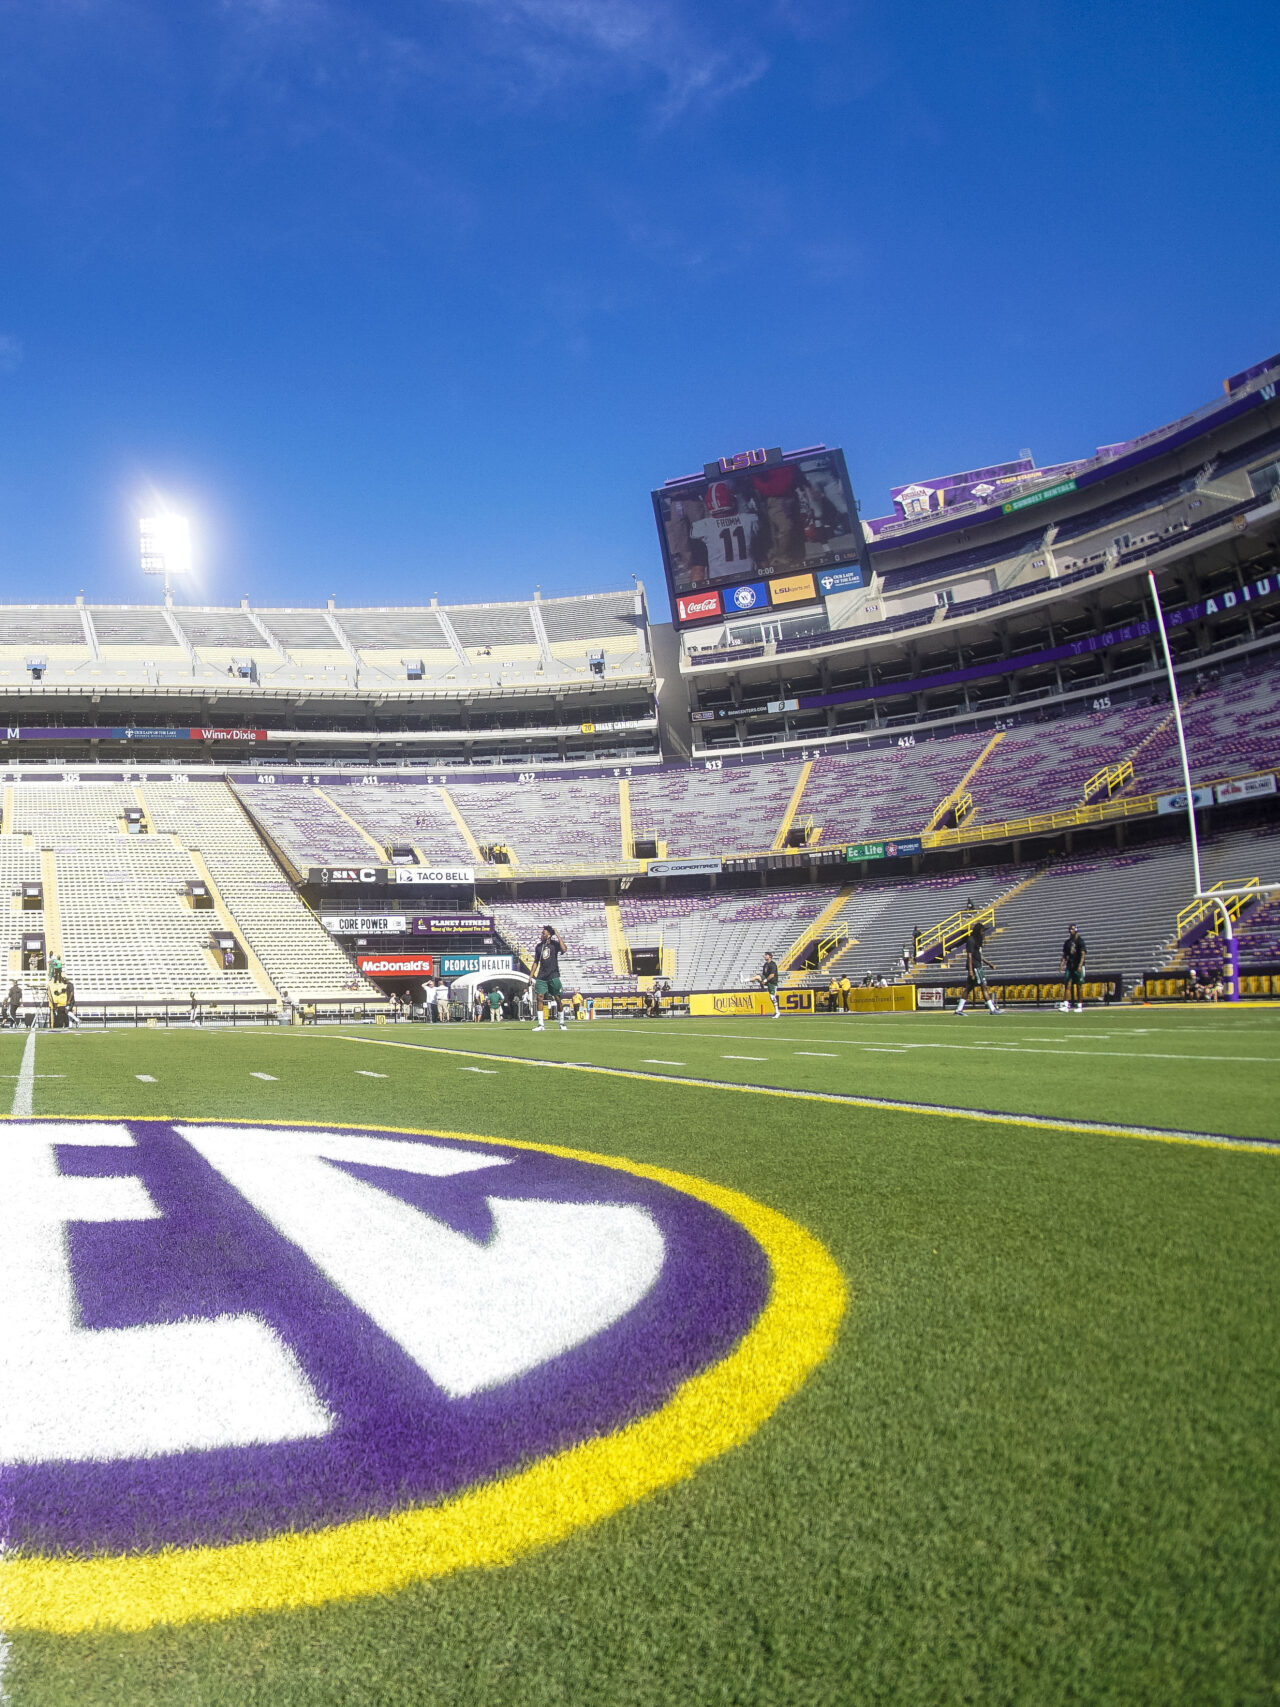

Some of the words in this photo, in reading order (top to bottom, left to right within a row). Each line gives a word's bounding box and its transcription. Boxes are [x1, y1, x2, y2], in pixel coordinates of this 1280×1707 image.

[718, 448, 768, 473] LSU
[720, 526, 748, 562] 11
[758, 567, 774, 576] 0:00
[1170, 573, 1280, 626] STADIU
[1093, 697, 1112, 710] 415
[897, 736, 915, 748] 414
[705, 760, 722, 770] 413
[62, 773, 80, 782] 305
[170, 774, 189, 782] 306
[258, 775, 275, 784] 410
[333, 870, 358, 878] SIX
[360, 869, 376, 882] C
[417, 872, 443, 880] TACO
[446, 872, 469, 880] BELL
[339, 919, 359, 930] CORE
[360, 919, 388, 930] POWER
[362, 961, 430, 971] McDonald's
[444, 960, 478, 971] PEOPLES
[482, 959, 510, 969] HEALTH
[920, 992, 942, 1000] ESPN
[713, 995, 753, 1011] LOUISIANA
[775, 994, 811, 1010] LSU
